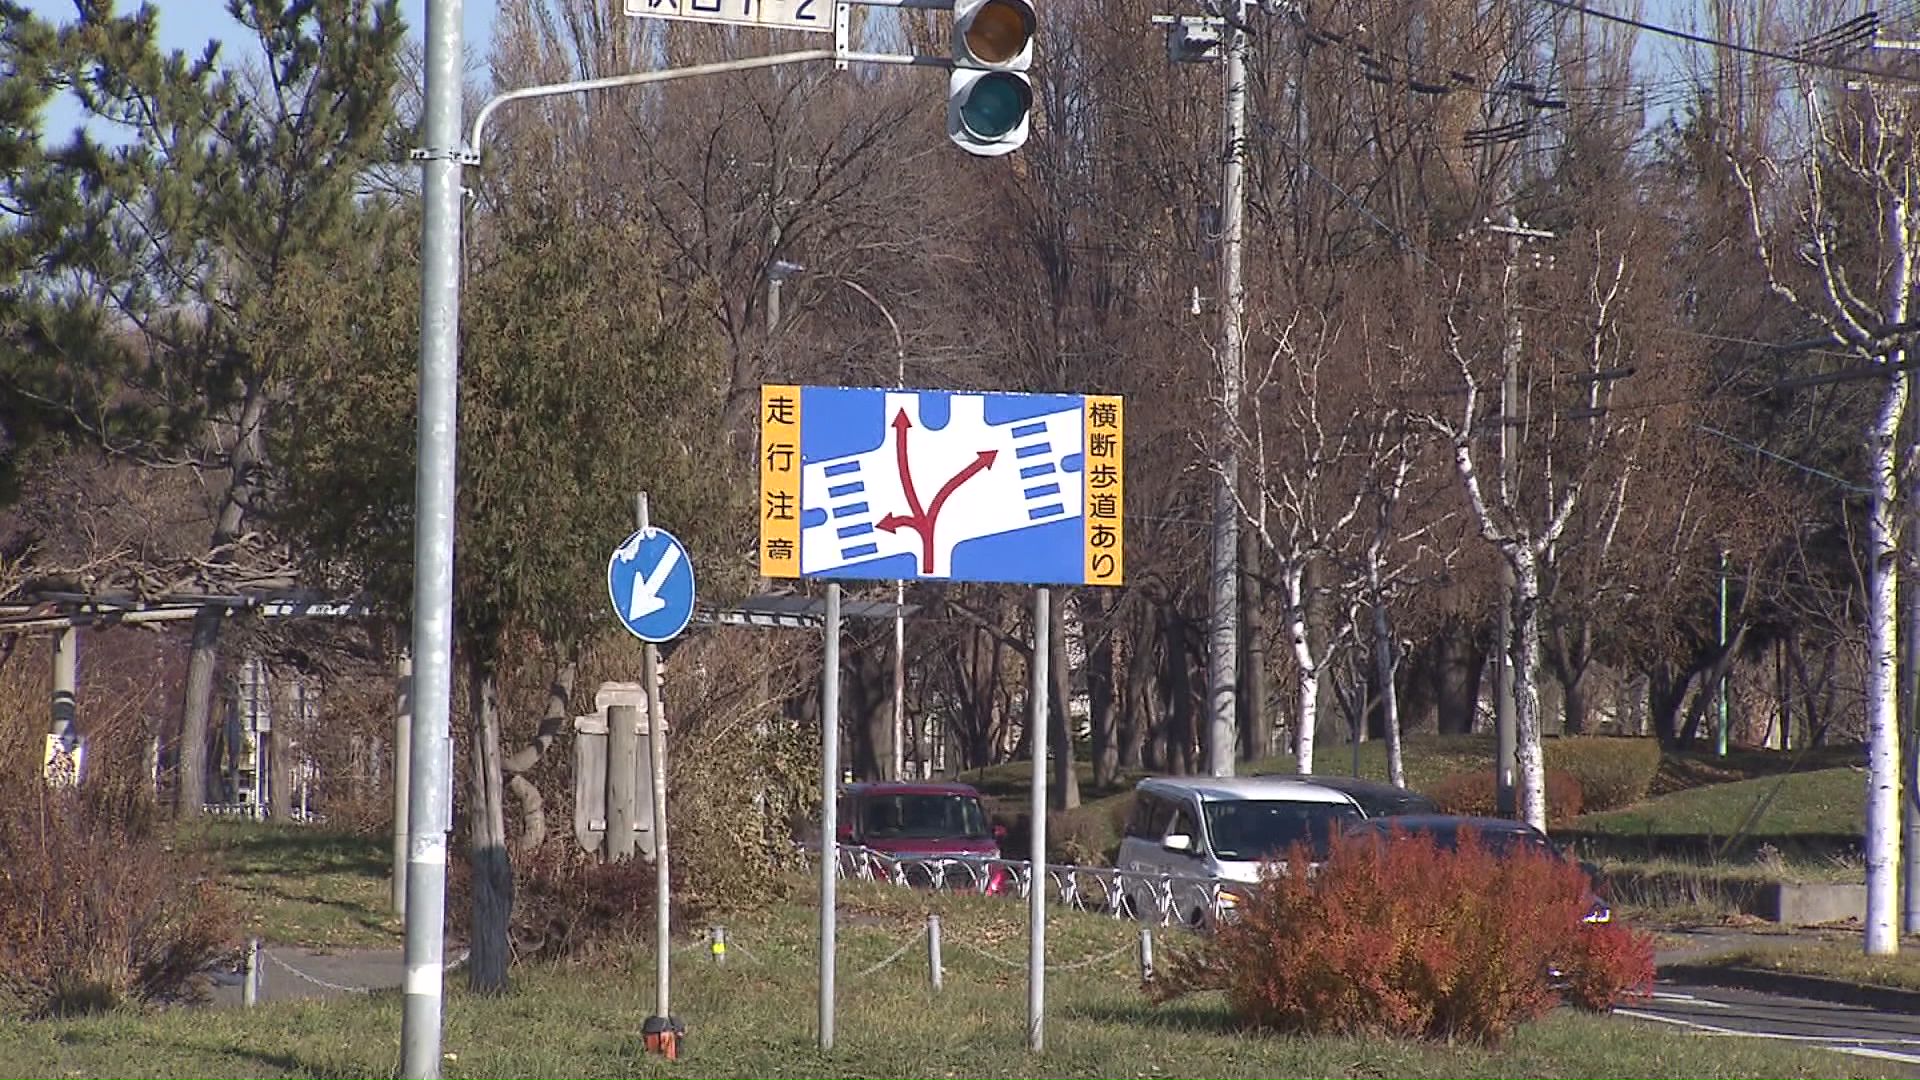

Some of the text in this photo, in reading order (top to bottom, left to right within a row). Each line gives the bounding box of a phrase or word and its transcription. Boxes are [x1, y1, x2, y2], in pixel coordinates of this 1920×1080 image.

[1089, 401, 1119, 579] 横断歩道あり
